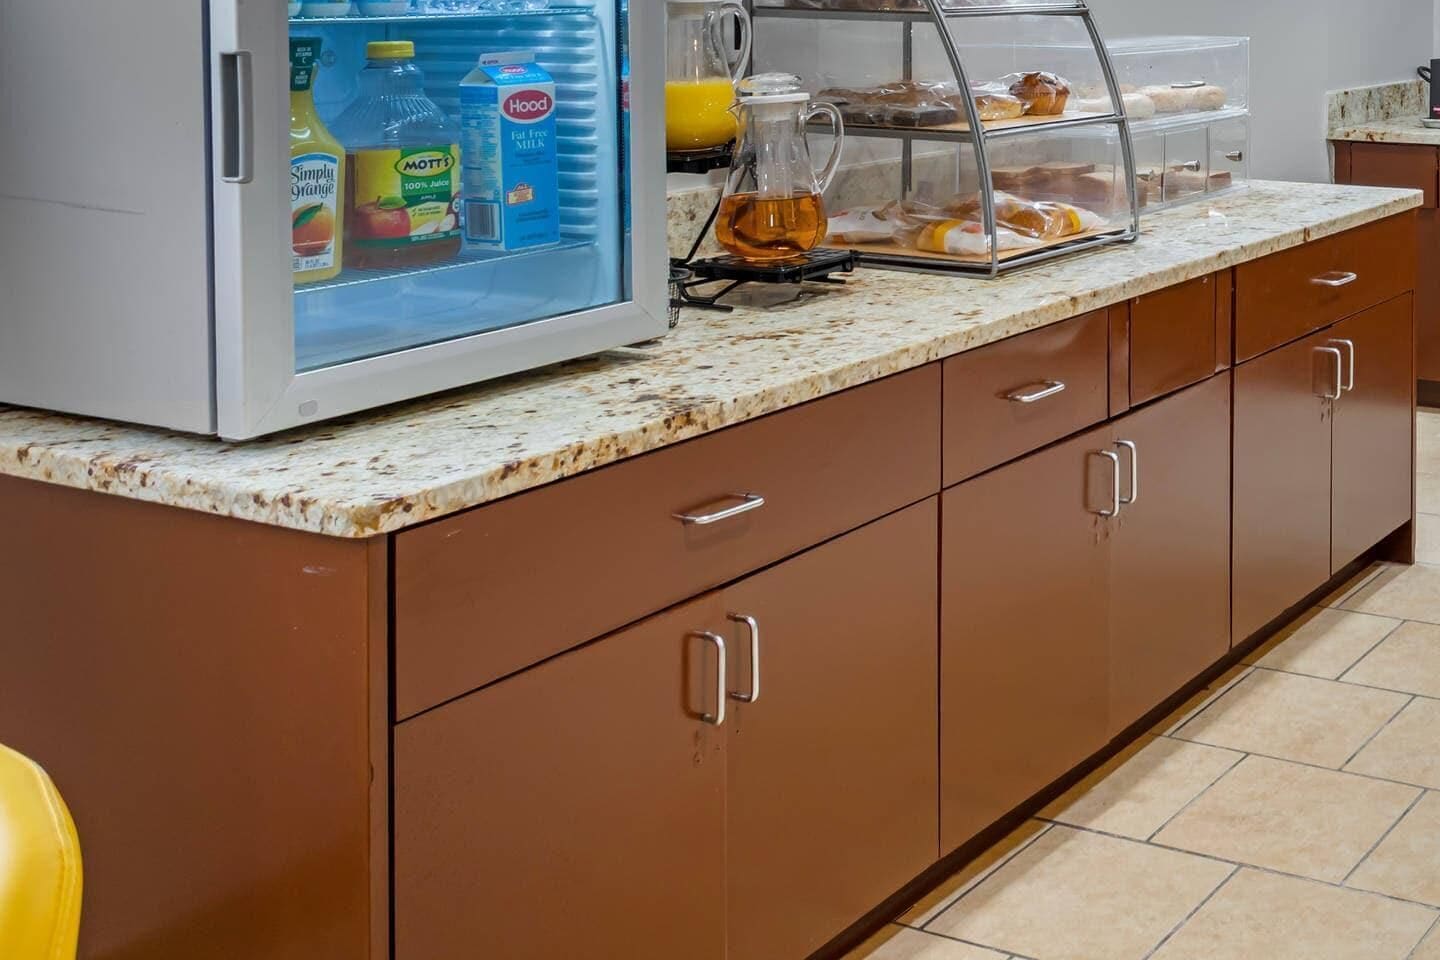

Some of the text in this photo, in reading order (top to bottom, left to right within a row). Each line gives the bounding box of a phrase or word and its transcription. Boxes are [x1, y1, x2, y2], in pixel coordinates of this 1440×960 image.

[509, 96, 549, 114] Hood
[511, 128, 549, 141] Fat Free
[516, 139, 545, 150] MILK
[291, 163, 335, 185] Simply
[291, 181, 335, 202] Orange
[404, 182, 428, 191] 100%
